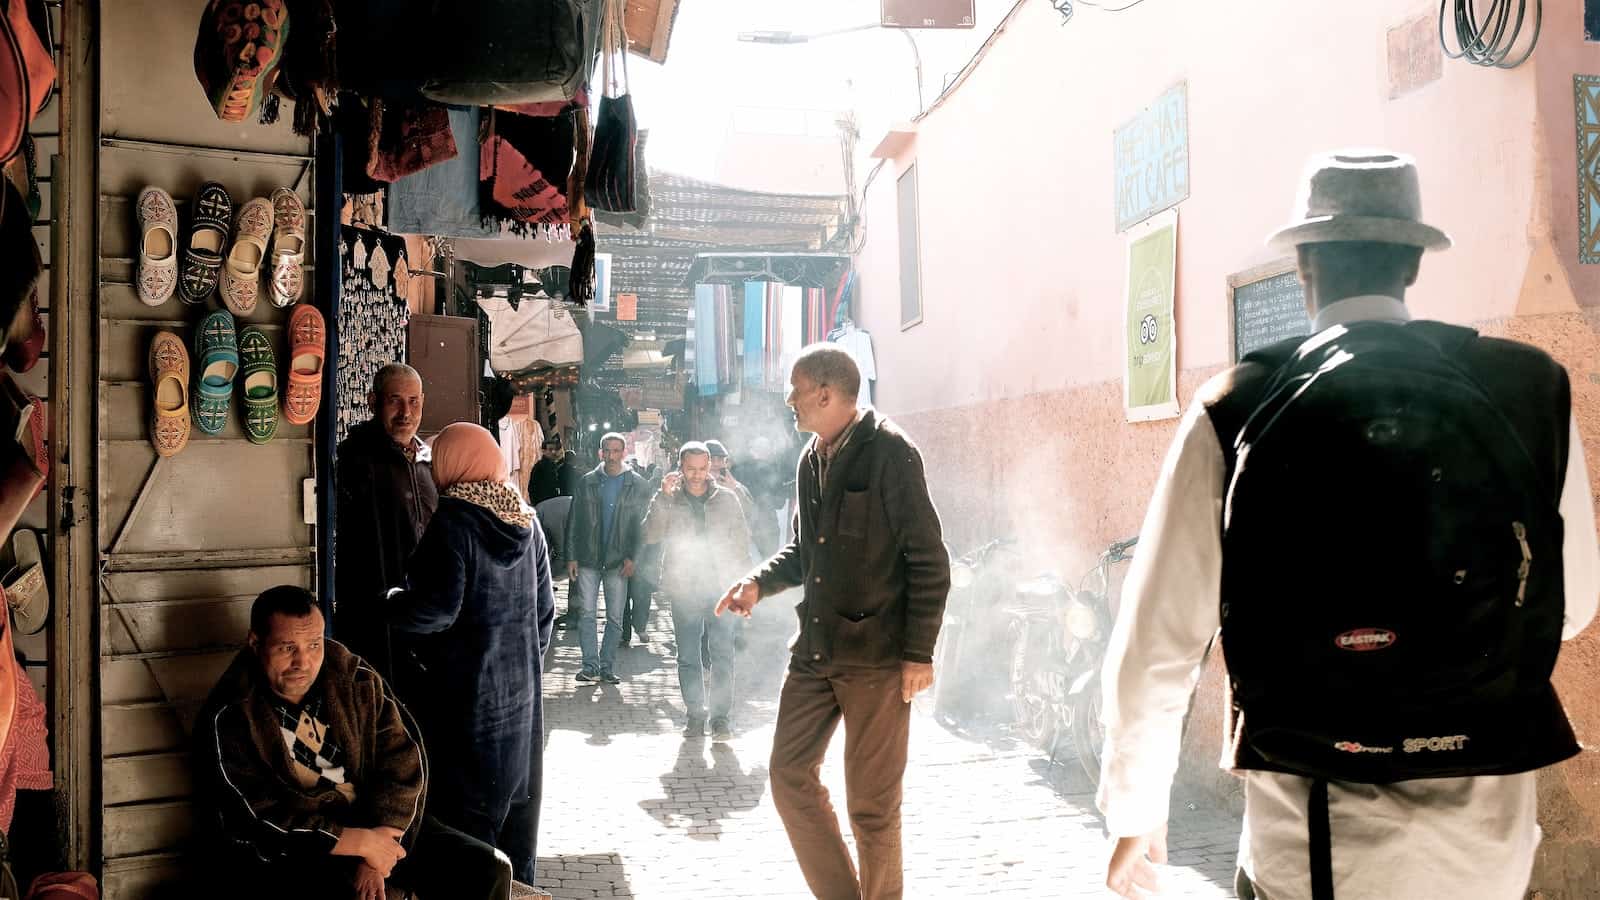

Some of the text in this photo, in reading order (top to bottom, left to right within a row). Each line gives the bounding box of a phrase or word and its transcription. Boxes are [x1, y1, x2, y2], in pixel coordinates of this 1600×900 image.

[1118, 147, 1184, 219] ART CAFE
[1340, 633, 1390, 646] EASTPAK
[1402, 734, 1470, 753] SPORT
